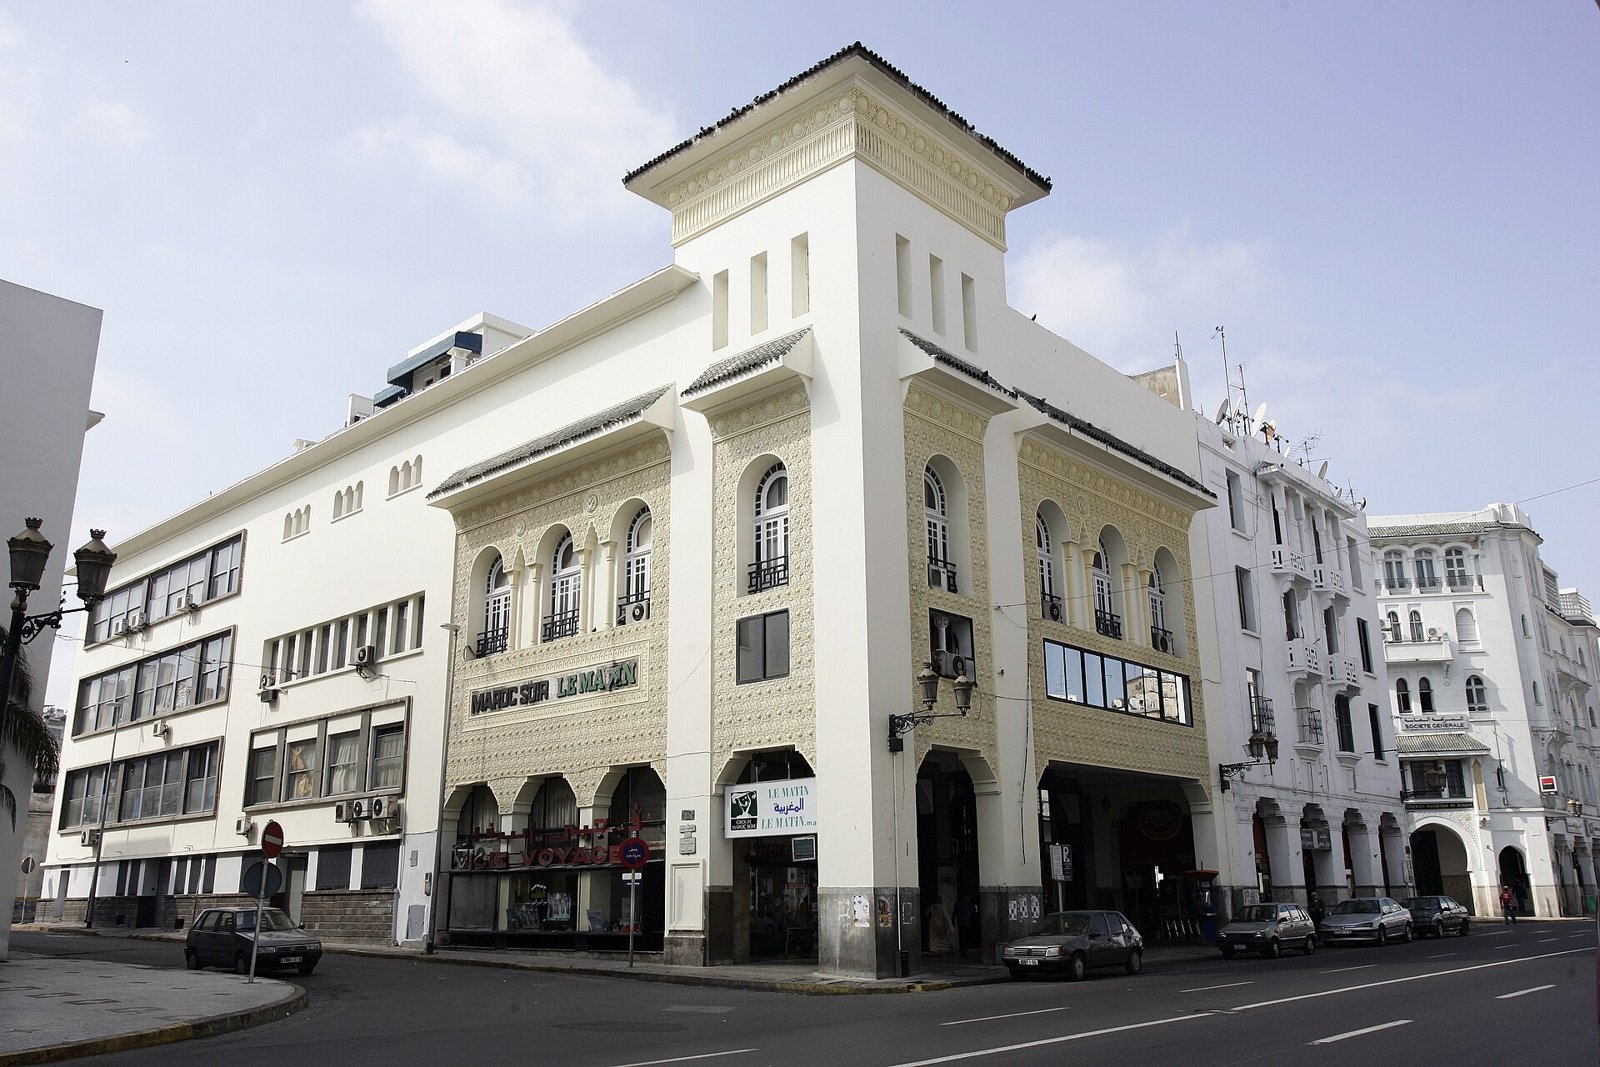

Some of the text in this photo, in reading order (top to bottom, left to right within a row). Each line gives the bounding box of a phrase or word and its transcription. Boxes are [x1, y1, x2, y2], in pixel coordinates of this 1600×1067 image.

[471, 687, 518, 715] MAROC
[520, 681, 550, 705] SOIR
[556, 674, 578, 698] LE
[768, 788, 780, 798] LE
[773, 797, 804, 815] المغربية
[761, 817, 775, 830] LE
